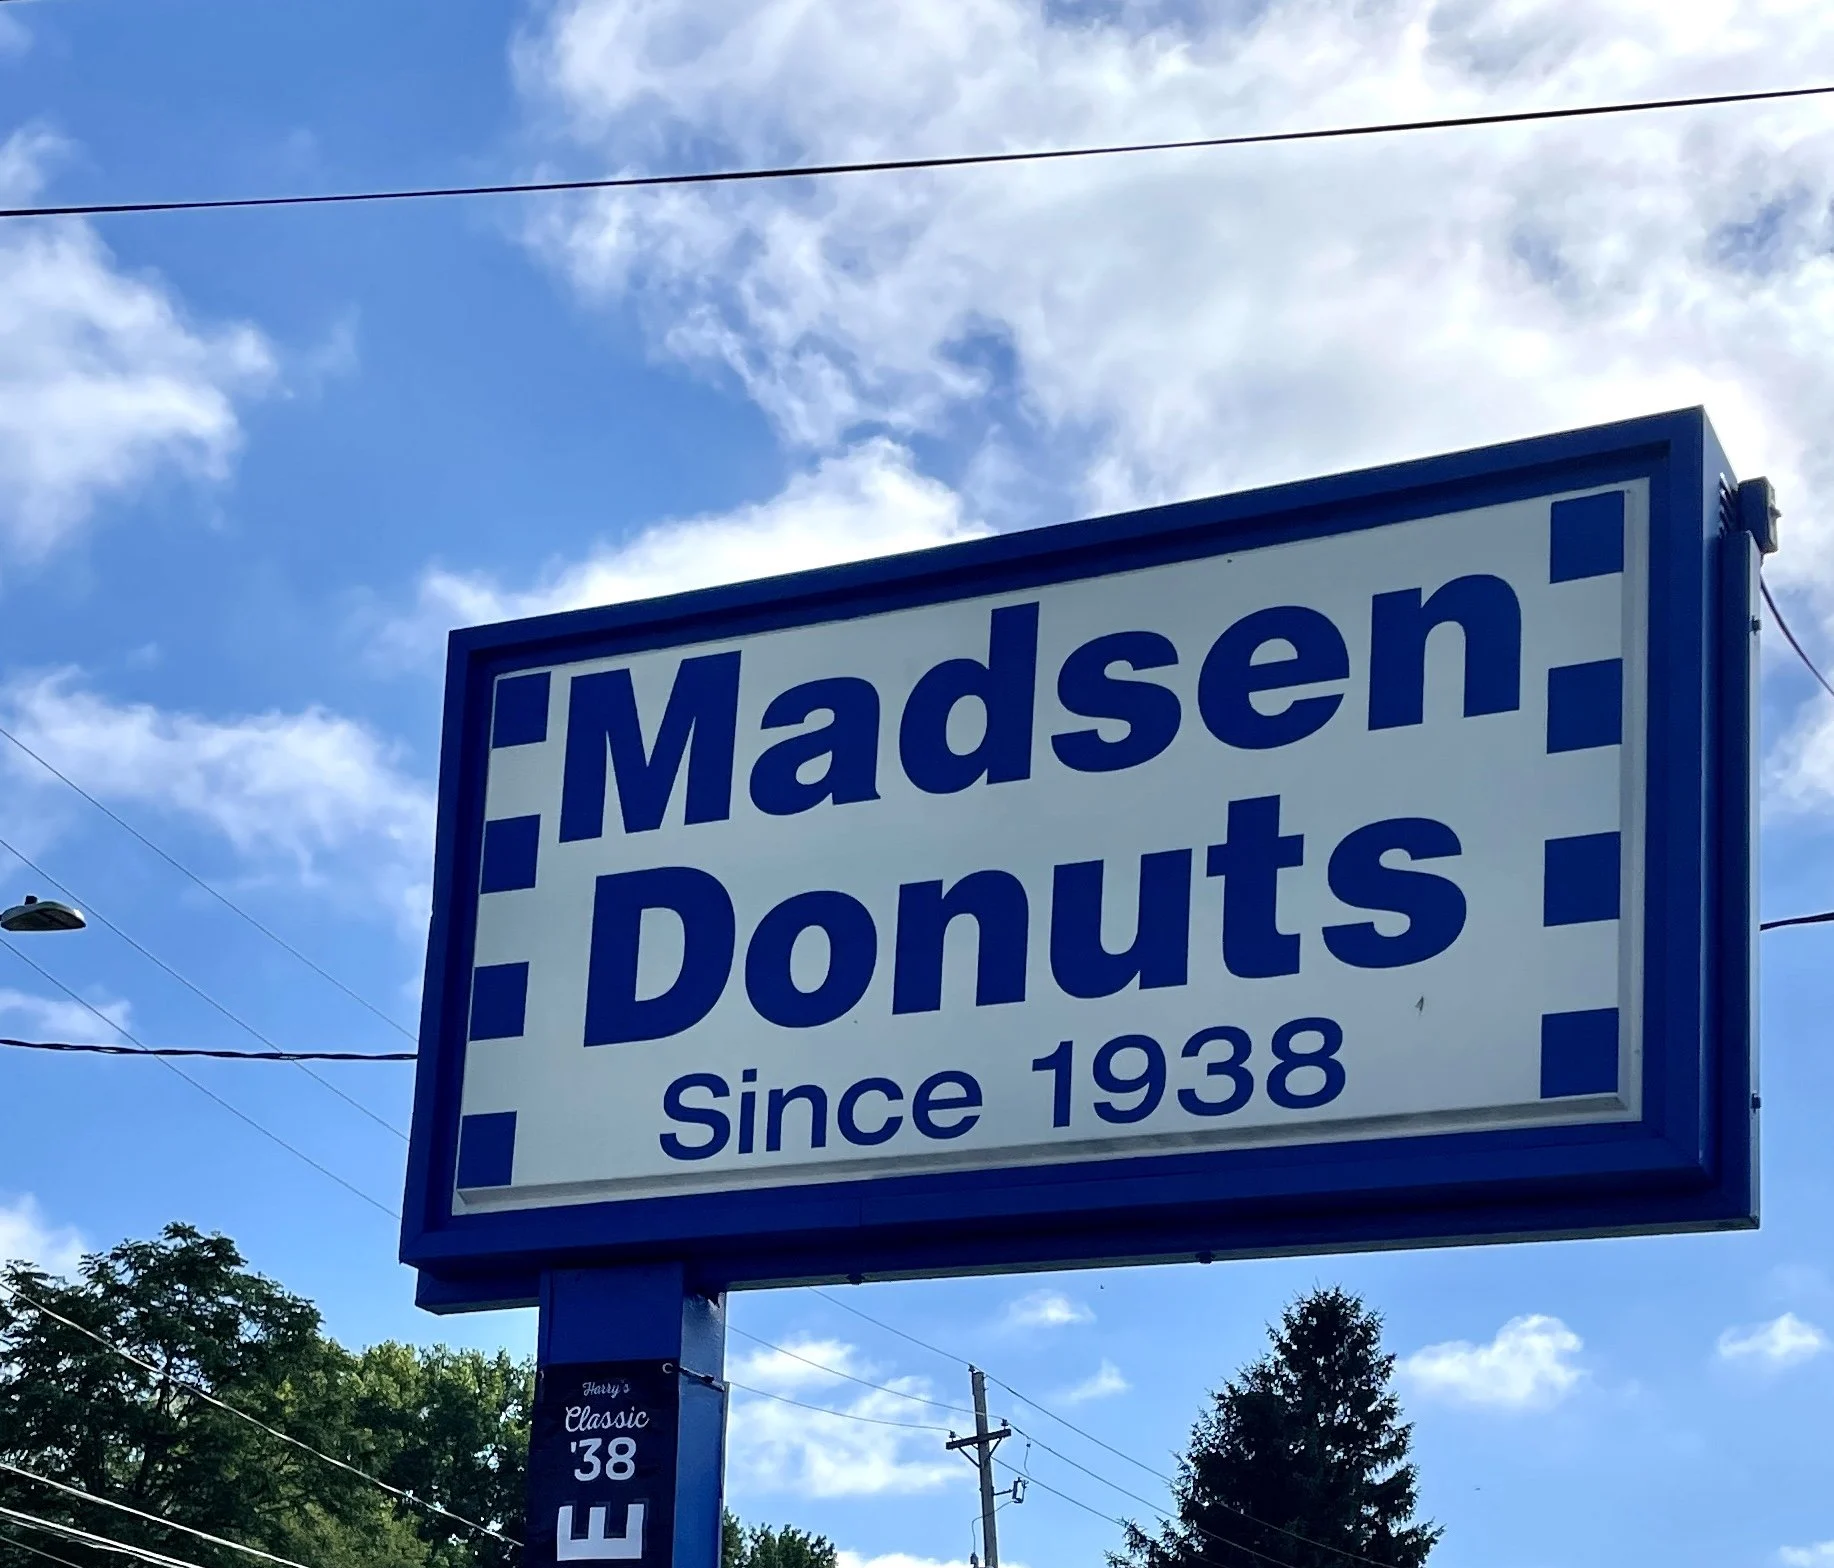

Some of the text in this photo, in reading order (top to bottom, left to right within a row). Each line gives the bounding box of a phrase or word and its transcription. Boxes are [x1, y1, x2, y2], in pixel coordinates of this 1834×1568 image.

[558, 573, 1522, 844] Madsen
[583, 793, 1468, 1048] Donuts
[659, 1016, 1347, 1161] Since 1938
[565, 1405, 650, 1433] Classic
[582, 1379, 631, 1399] Harry's
[570, 1436, 638, 1482] '38
